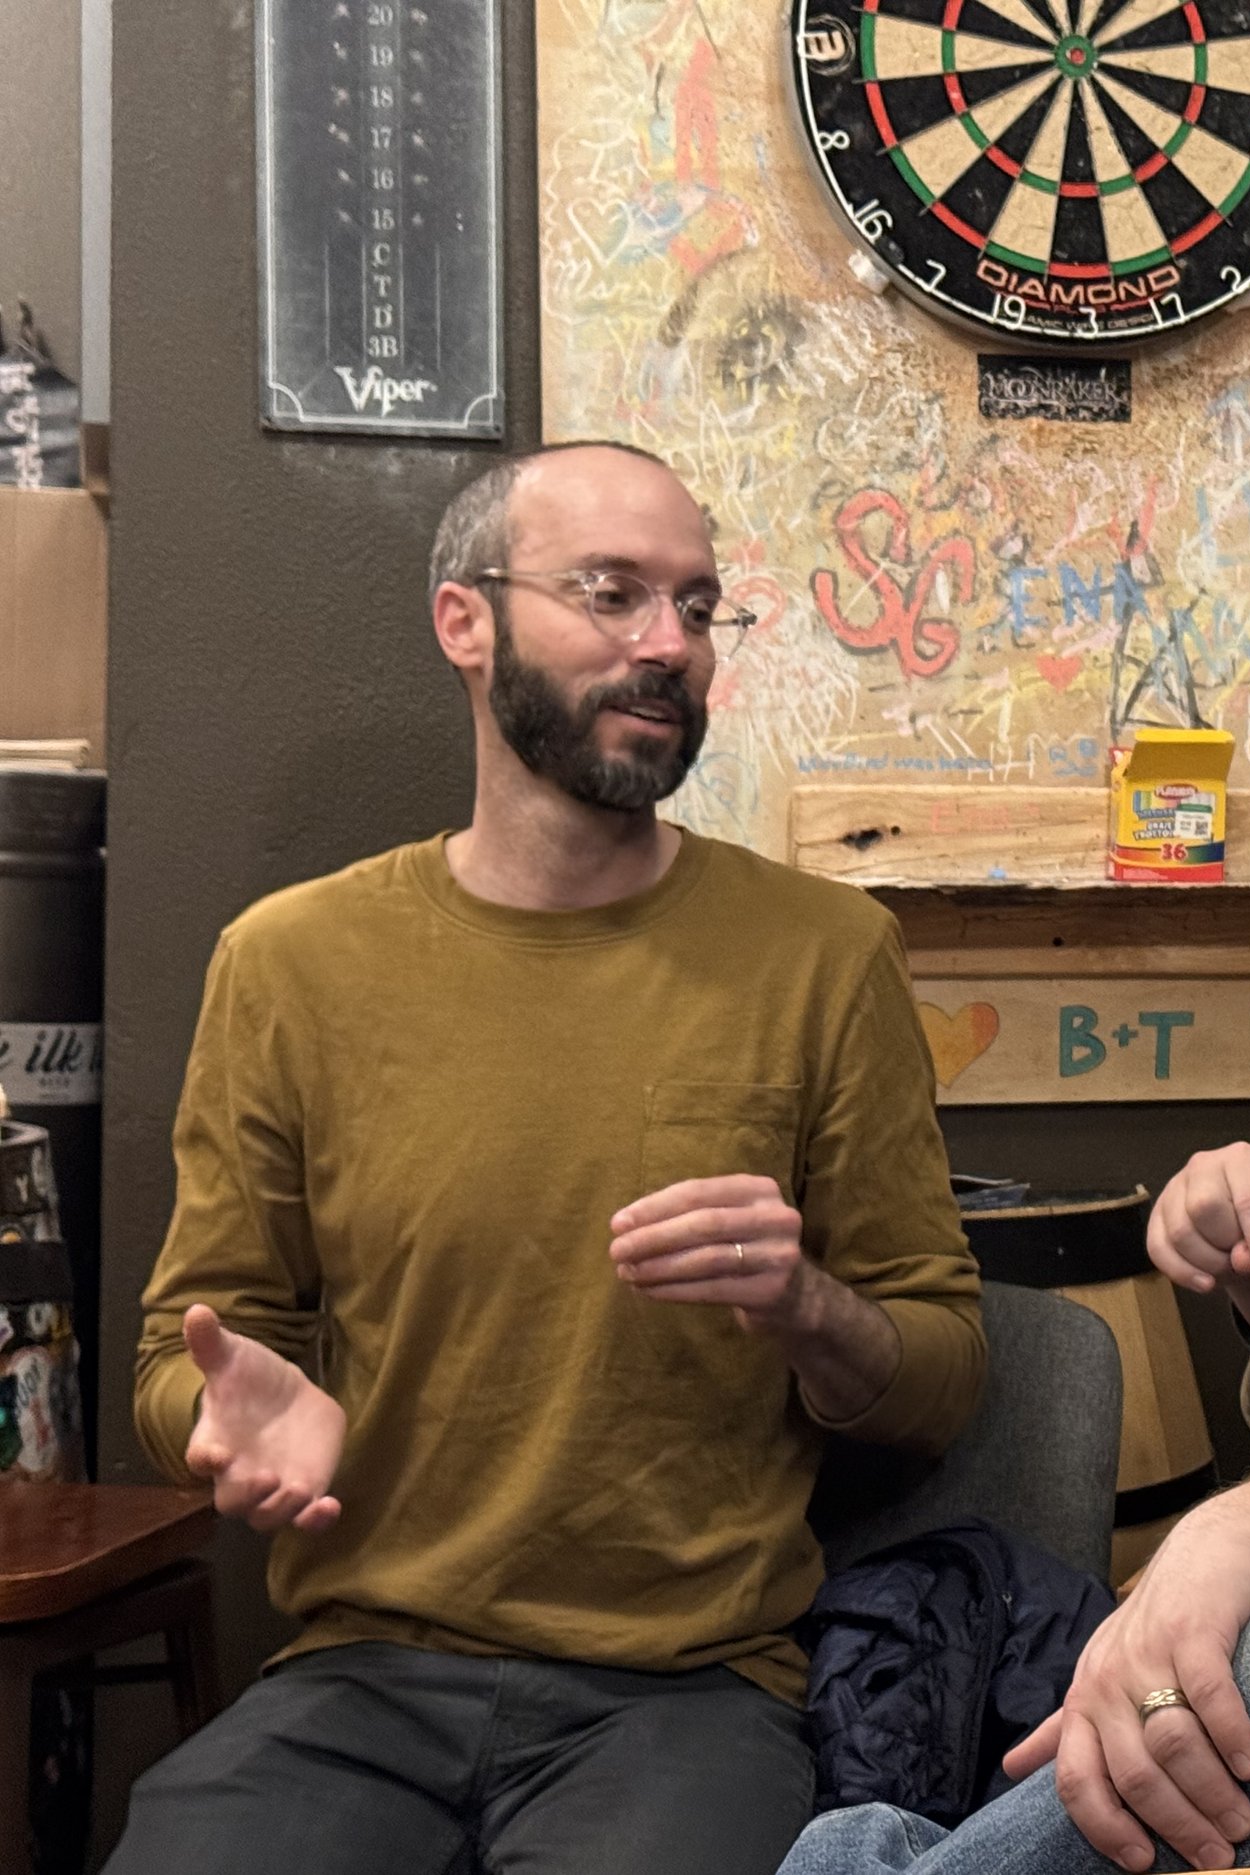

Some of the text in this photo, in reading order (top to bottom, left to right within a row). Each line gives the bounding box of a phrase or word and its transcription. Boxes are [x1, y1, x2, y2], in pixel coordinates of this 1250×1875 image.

[368, 4, 393, 26] 20
[369, 44, 393, 67] 19
[370, 86, 394, 108] 18
[370, 126, 392, 149] 17
[817, 130, 850, 150] 8
[371, 168, 394, 190] 16
[372, 208, 395, 230] 15
[852, 198, 893, 242] 16
[373, 273, 392, 297] T
[976, 259, 1181, 306] DIAMOND
[1220, 265, 1247, 294] 2
[991, 293, 1026, 330] 19
[1148, 292, 1186, 327] 17
[1078, 305, 1098, 338] 3
[368, 335, 398, 358] 3B
[334, 365, 438, 416] Viper
[1161, 843, 1188, 861] 36
